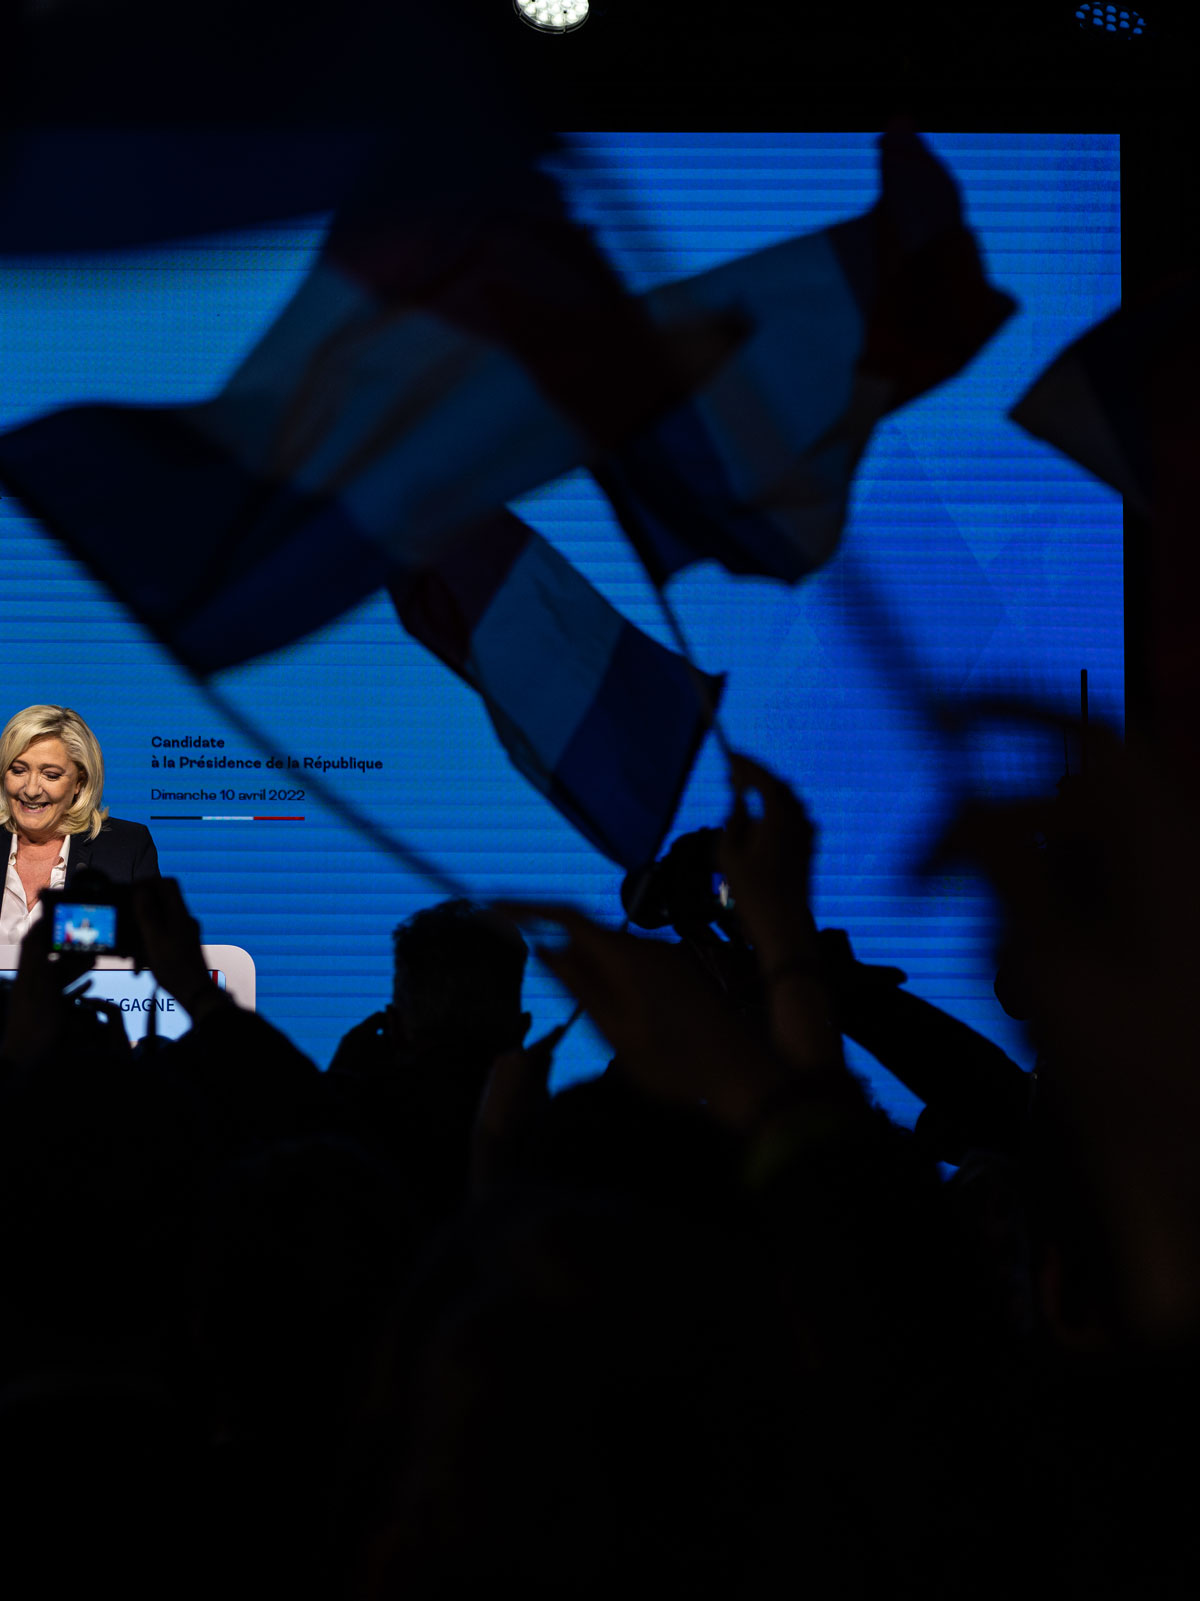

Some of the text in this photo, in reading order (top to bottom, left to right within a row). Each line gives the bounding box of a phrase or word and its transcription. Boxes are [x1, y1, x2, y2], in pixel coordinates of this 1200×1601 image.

[151, 735, 225, 749] Candidate
[151, 754, 383, 774] à la Présidence de la République
[150, 787, 306, 802] Dimanche 10 avril 2022
[119, 998, 176, 1013] GAGNE
